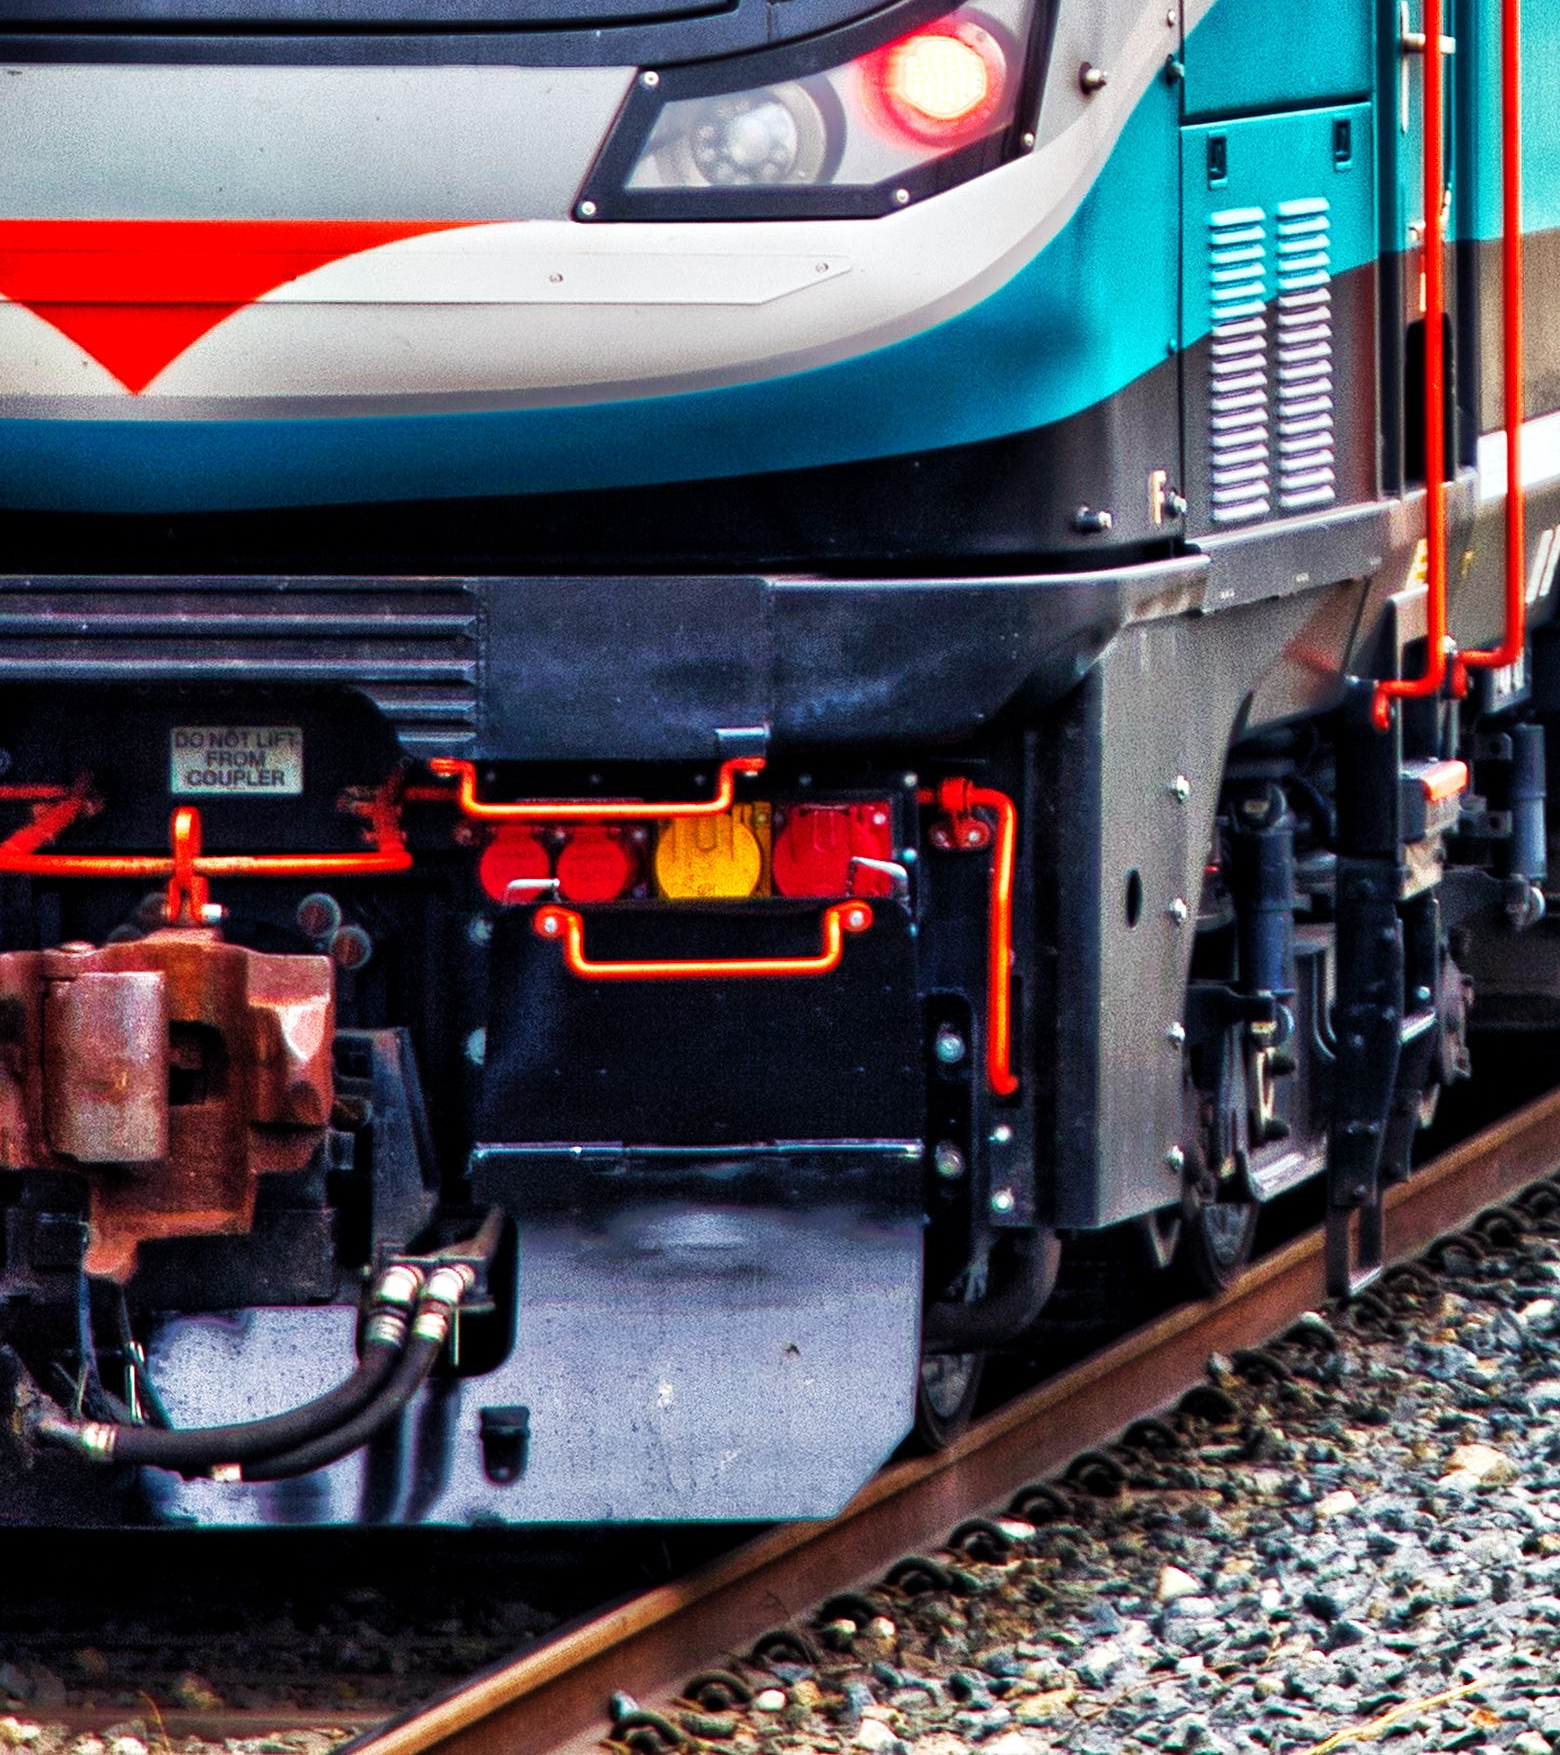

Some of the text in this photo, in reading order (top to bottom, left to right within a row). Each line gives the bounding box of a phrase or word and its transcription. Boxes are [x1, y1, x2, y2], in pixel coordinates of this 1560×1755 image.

[175, 729, 296, 748] DO NOT LIFT
[205, 750, 267, 768] FROM
[187, 768, 286, 787] COUPLER
